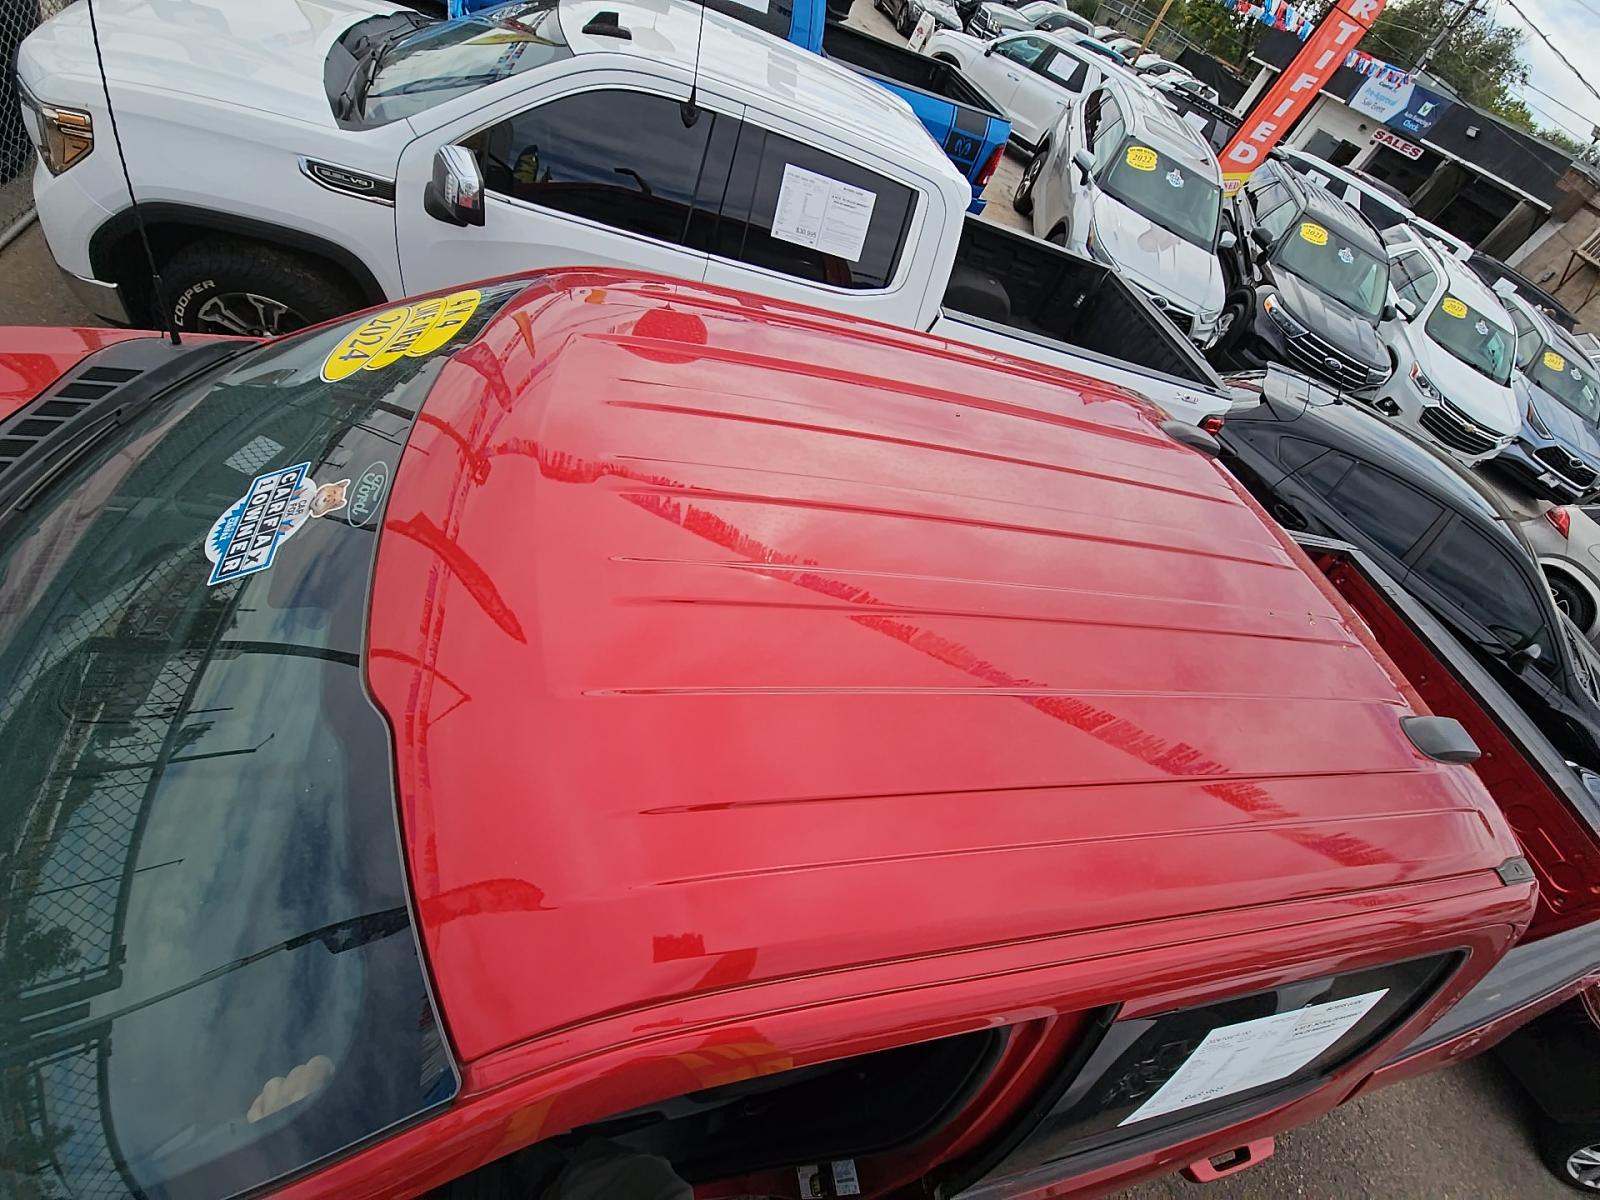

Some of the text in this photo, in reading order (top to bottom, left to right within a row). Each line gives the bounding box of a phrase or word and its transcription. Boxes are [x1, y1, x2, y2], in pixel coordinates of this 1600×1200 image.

[1374, 131, 1421, 157] SALES
[174, 279, 217, 326] COOPER
[338, 315, 401, 361] 2024
[257, 479, 274, 491] 1
[353, 472, 385, 516] Ford
[221, 493, 268, 574] OWNER
[244, 471, 298, 565] CARFAX
